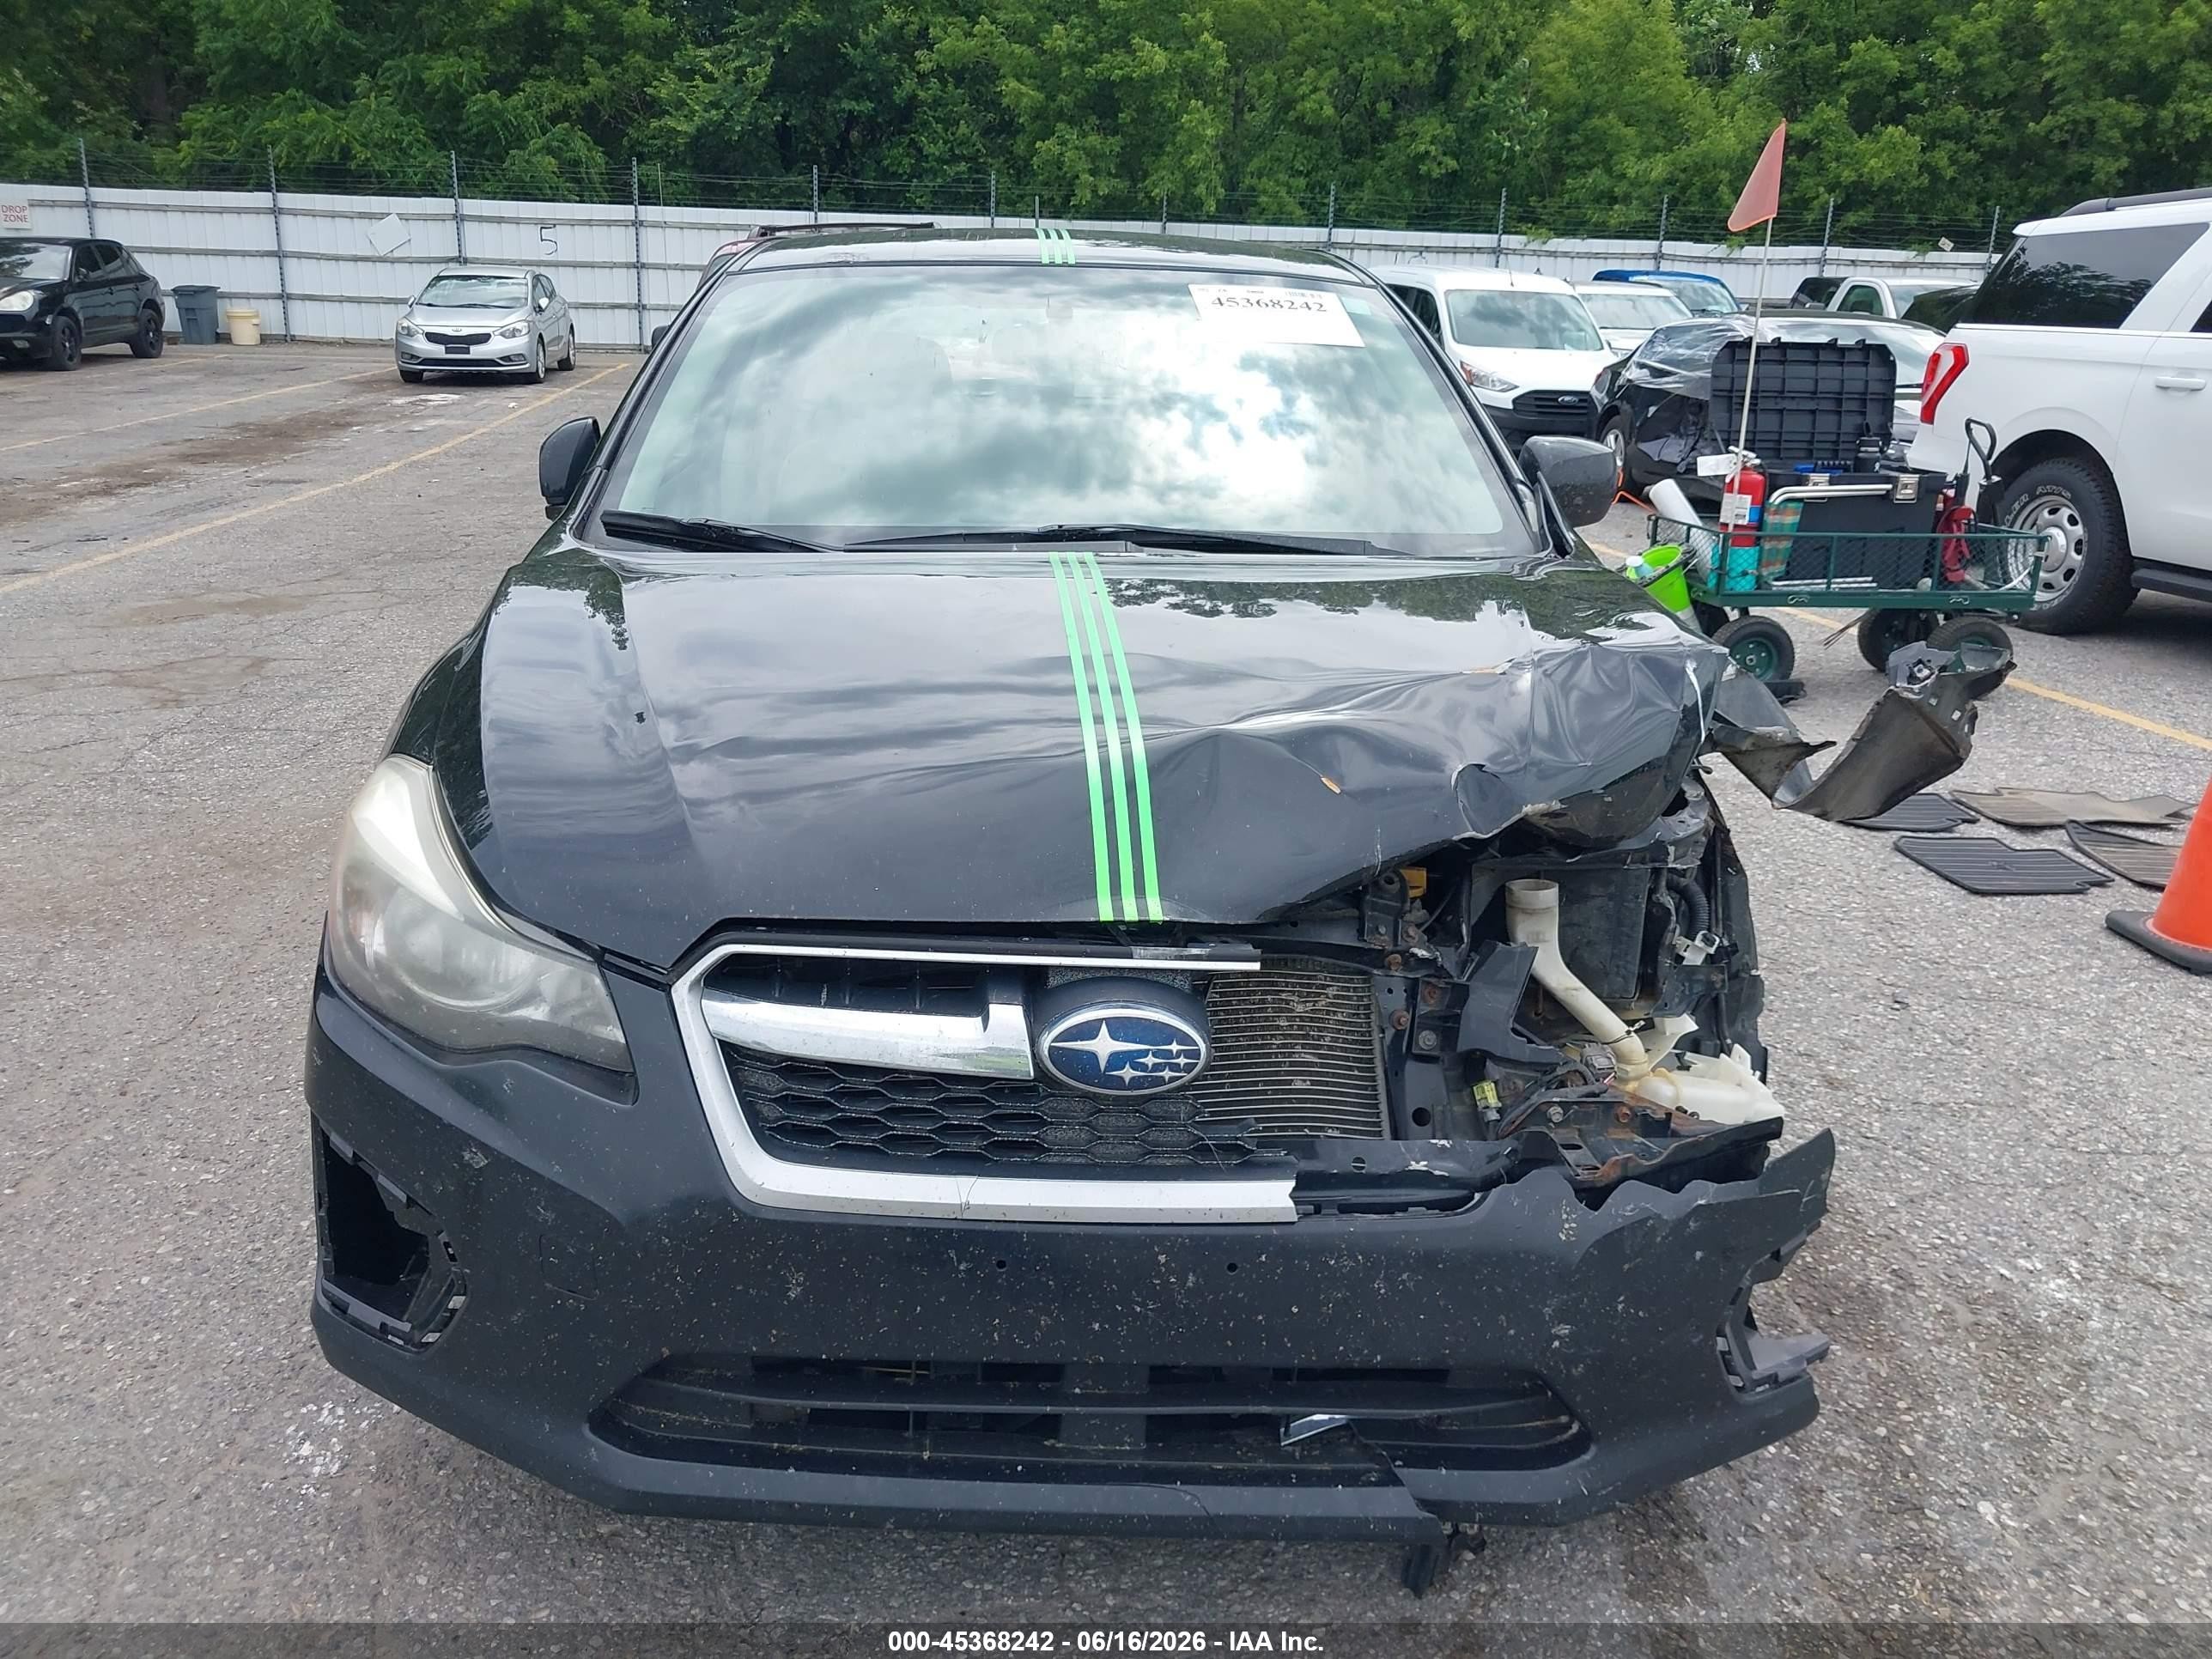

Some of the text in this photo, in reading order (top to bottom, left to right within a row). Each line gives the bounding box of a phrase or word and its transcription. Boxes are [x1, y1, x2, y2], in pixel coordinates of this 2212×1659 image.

[1, 204, 27, 214] DROP
[3, 214, 28, 222] ZONE
[539, 224, 557, 255] 5
[1211, 296, 1327, 312] 45368242
